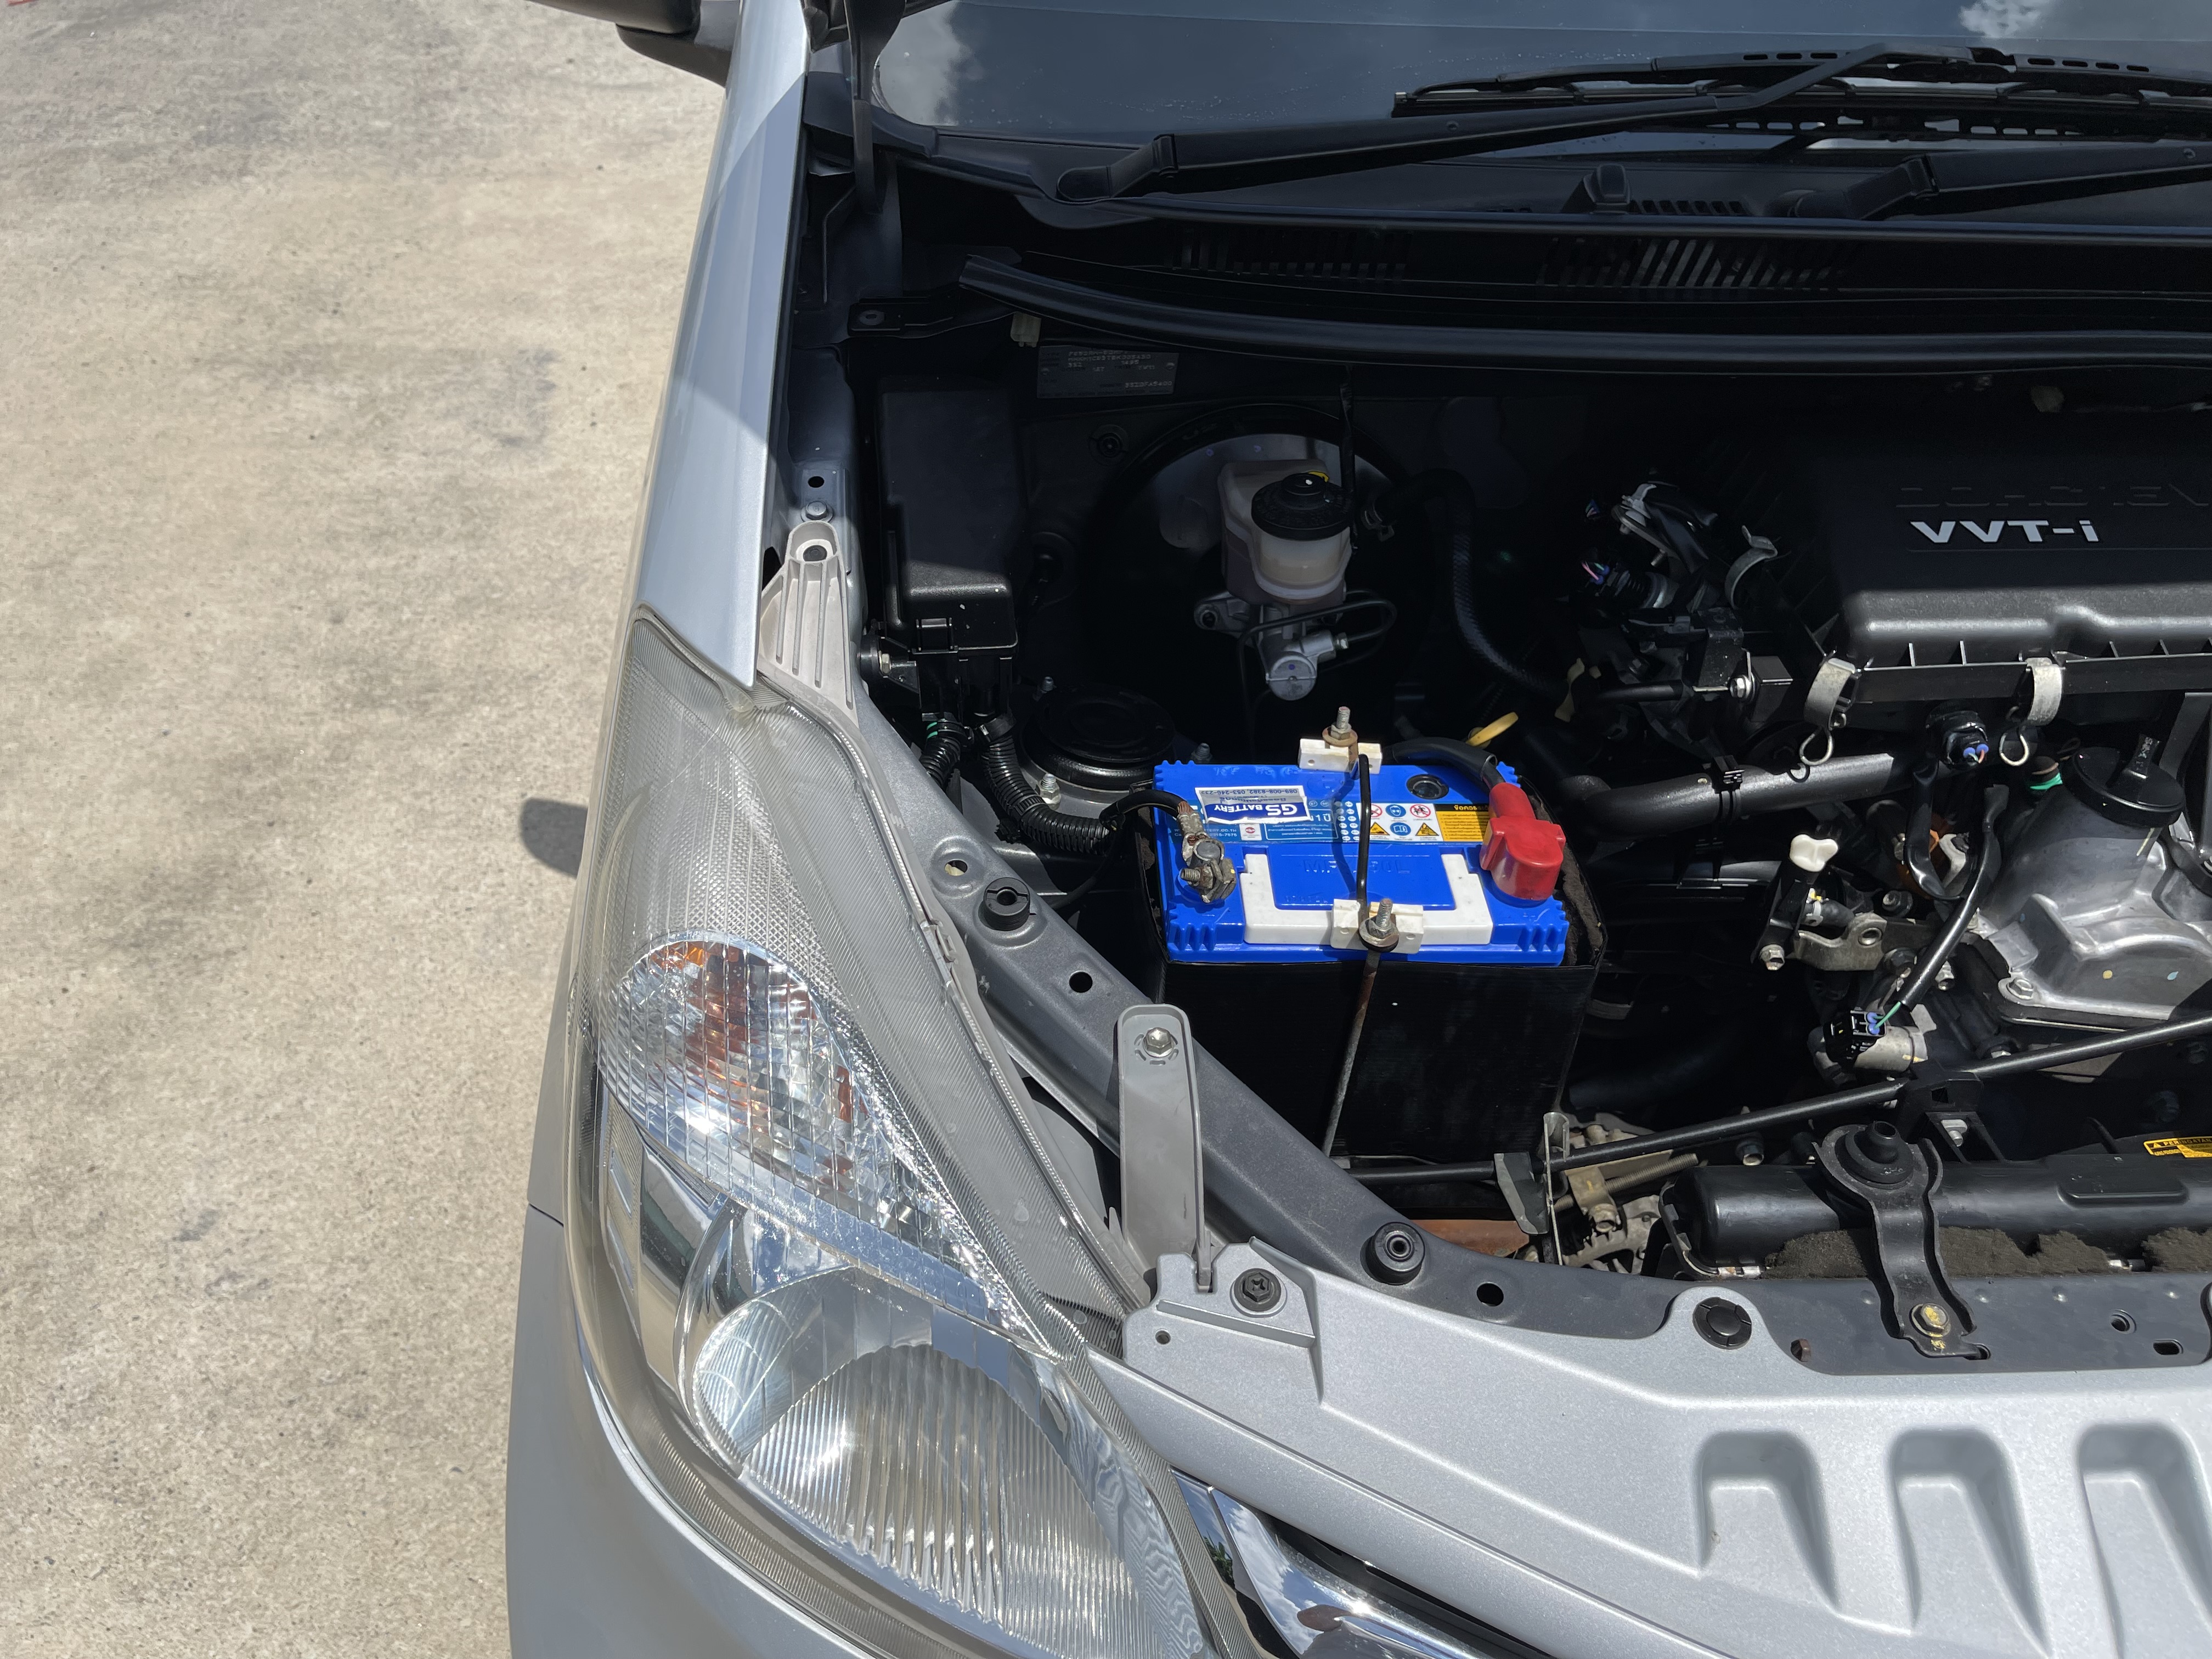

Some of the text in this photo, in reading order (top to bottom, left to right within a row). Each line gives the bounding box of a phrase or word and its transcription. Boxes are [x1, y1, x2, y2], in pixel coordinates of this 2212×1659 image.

[1910, 520, 2099, 543] VVT-i
[1214, 804, 1297, 816] GS BATTERY
